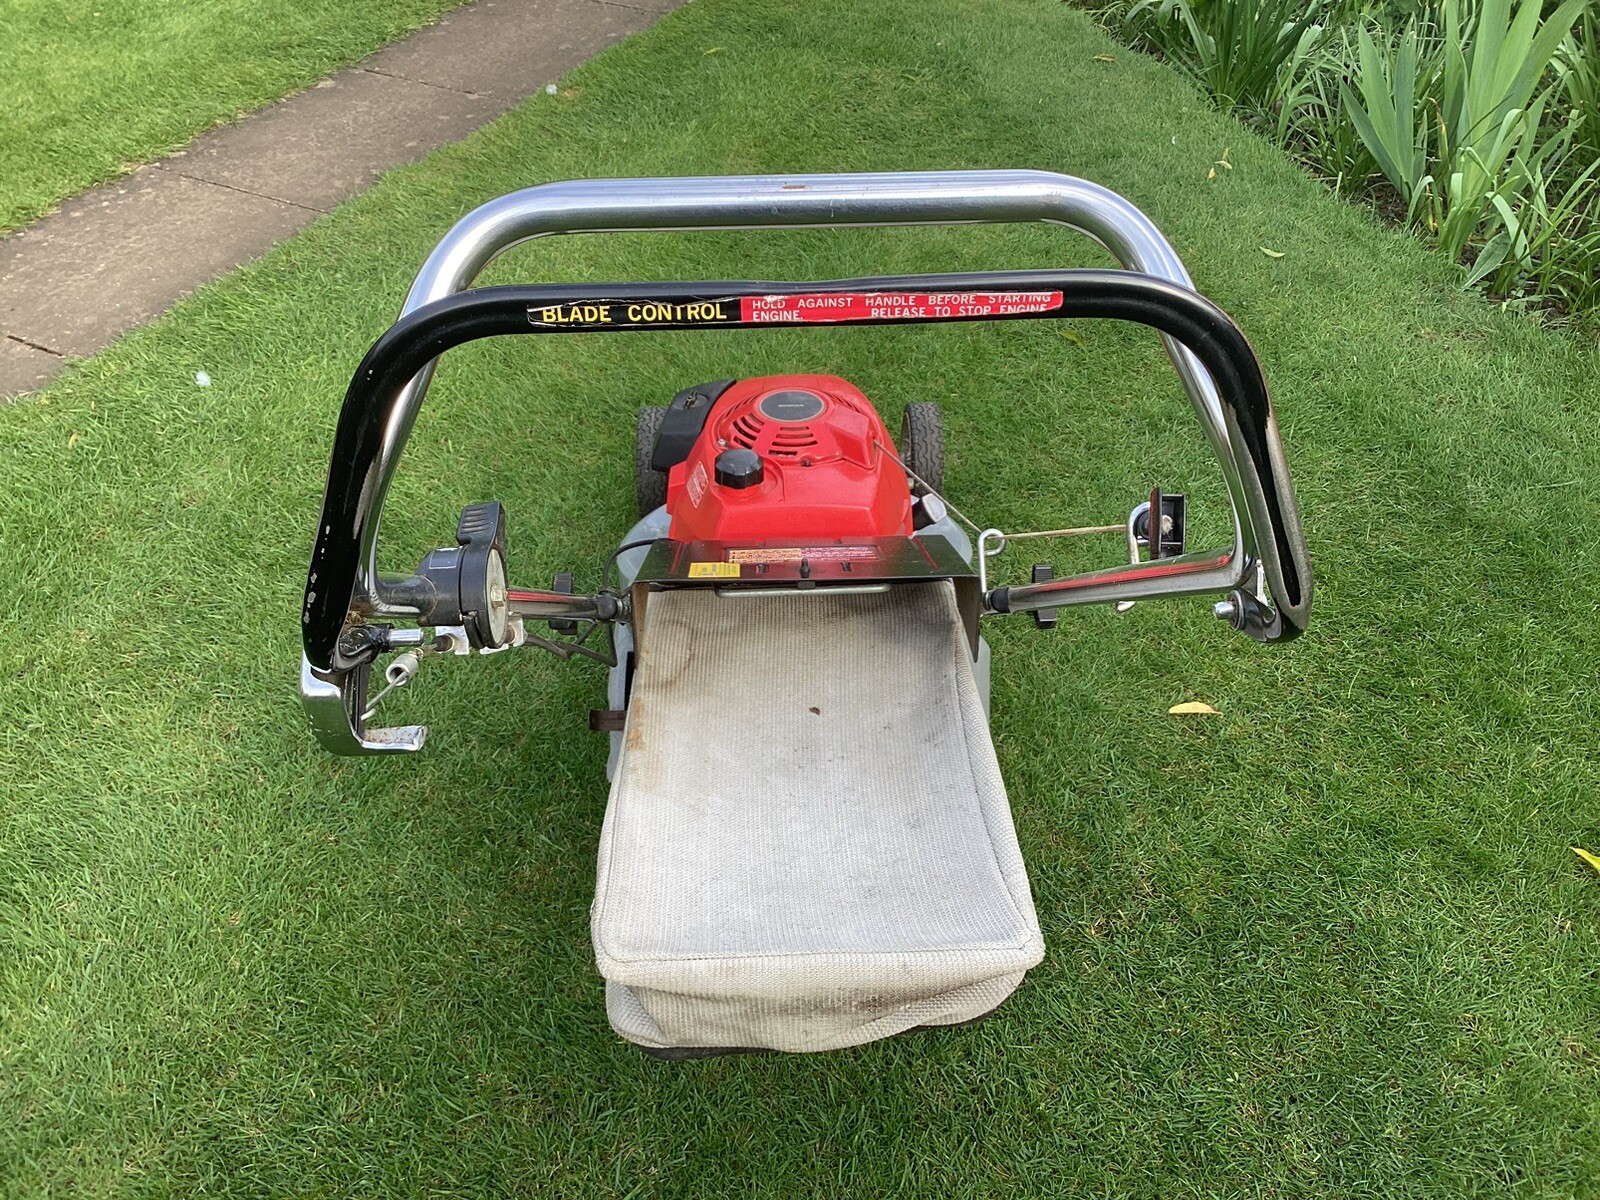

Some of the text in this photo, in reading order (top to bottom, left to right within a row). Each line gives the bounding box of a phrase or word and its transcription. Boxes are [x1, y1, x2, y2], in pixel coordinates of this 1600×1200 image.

[752, 294, 1051, 310] HOLD AGAINST HANDLE BEFORE STARTING
[542, 303, 727, 323] BLADE CONTROL
[752, 303, 1048, 322] ENGINE. RELEASE TO STOP ENGINE
